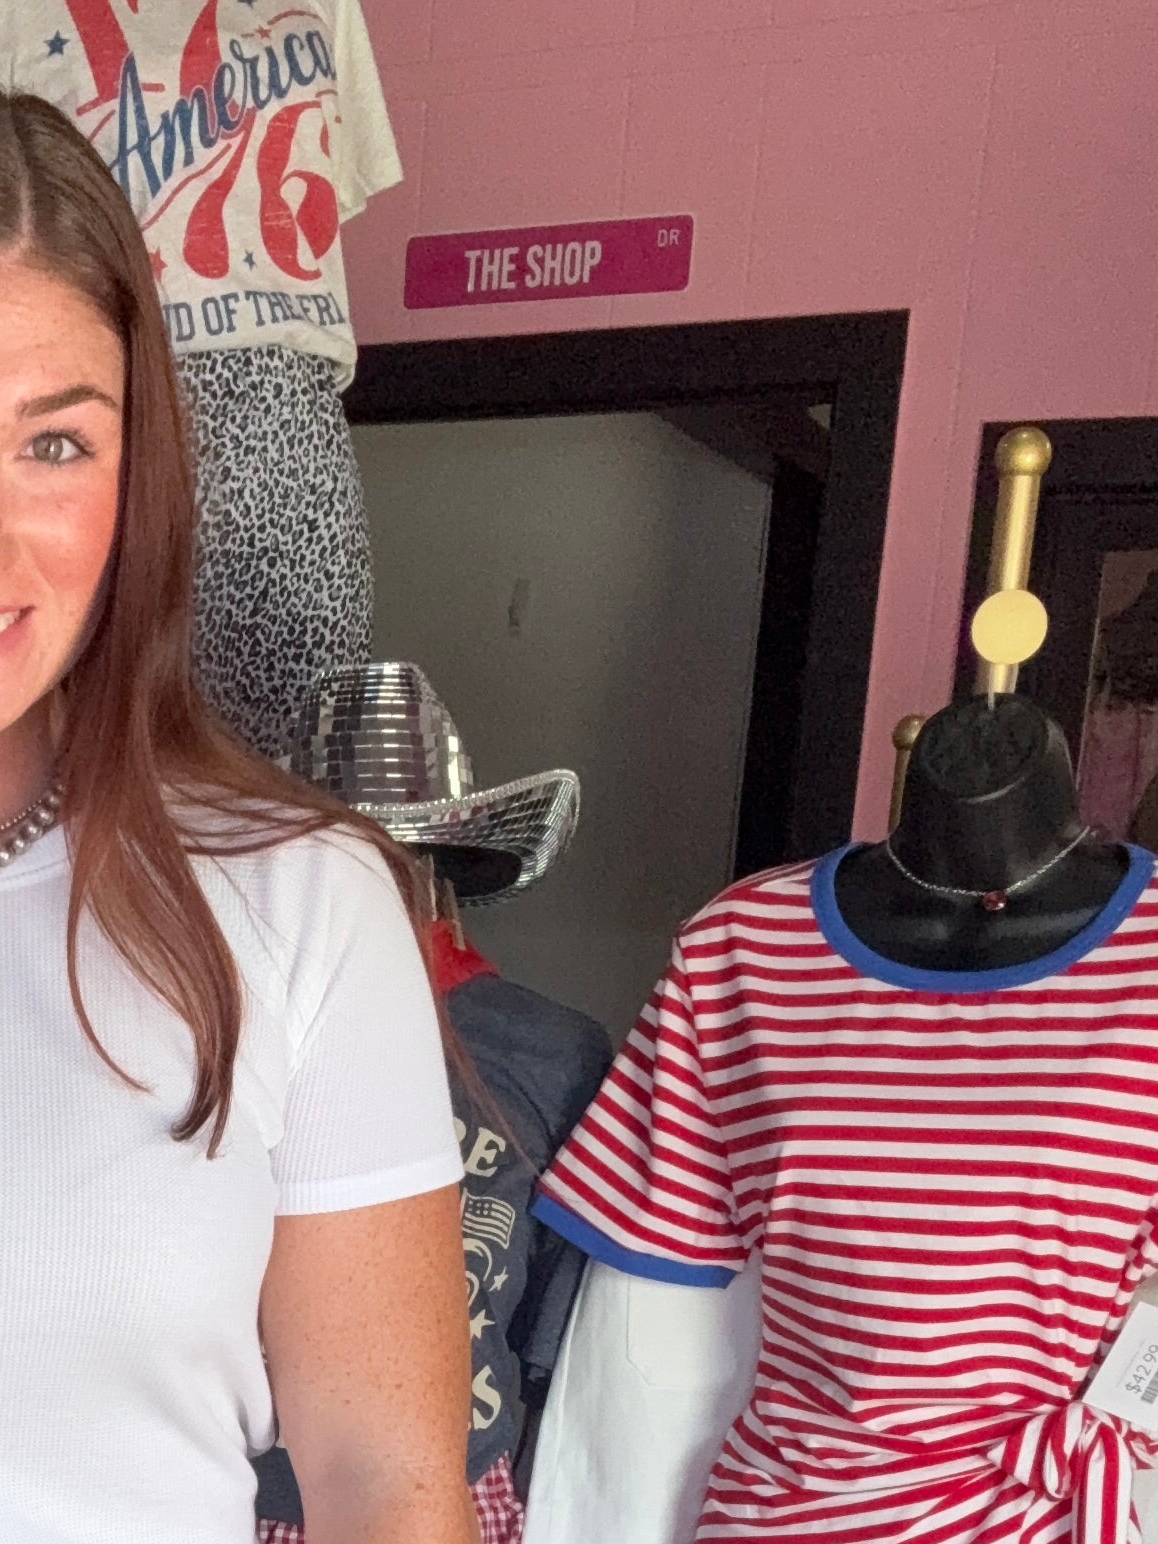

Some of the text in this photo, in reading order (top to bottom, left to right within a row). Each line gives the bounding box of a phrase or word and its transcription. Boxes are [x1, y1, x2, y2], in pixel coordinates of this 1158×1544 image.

[108, 29, 337, 200] America
[657, 228, 679, 248] DR
[464, 240, 602, 293] THE SHOP
[201, 292, 240, 336] OF
